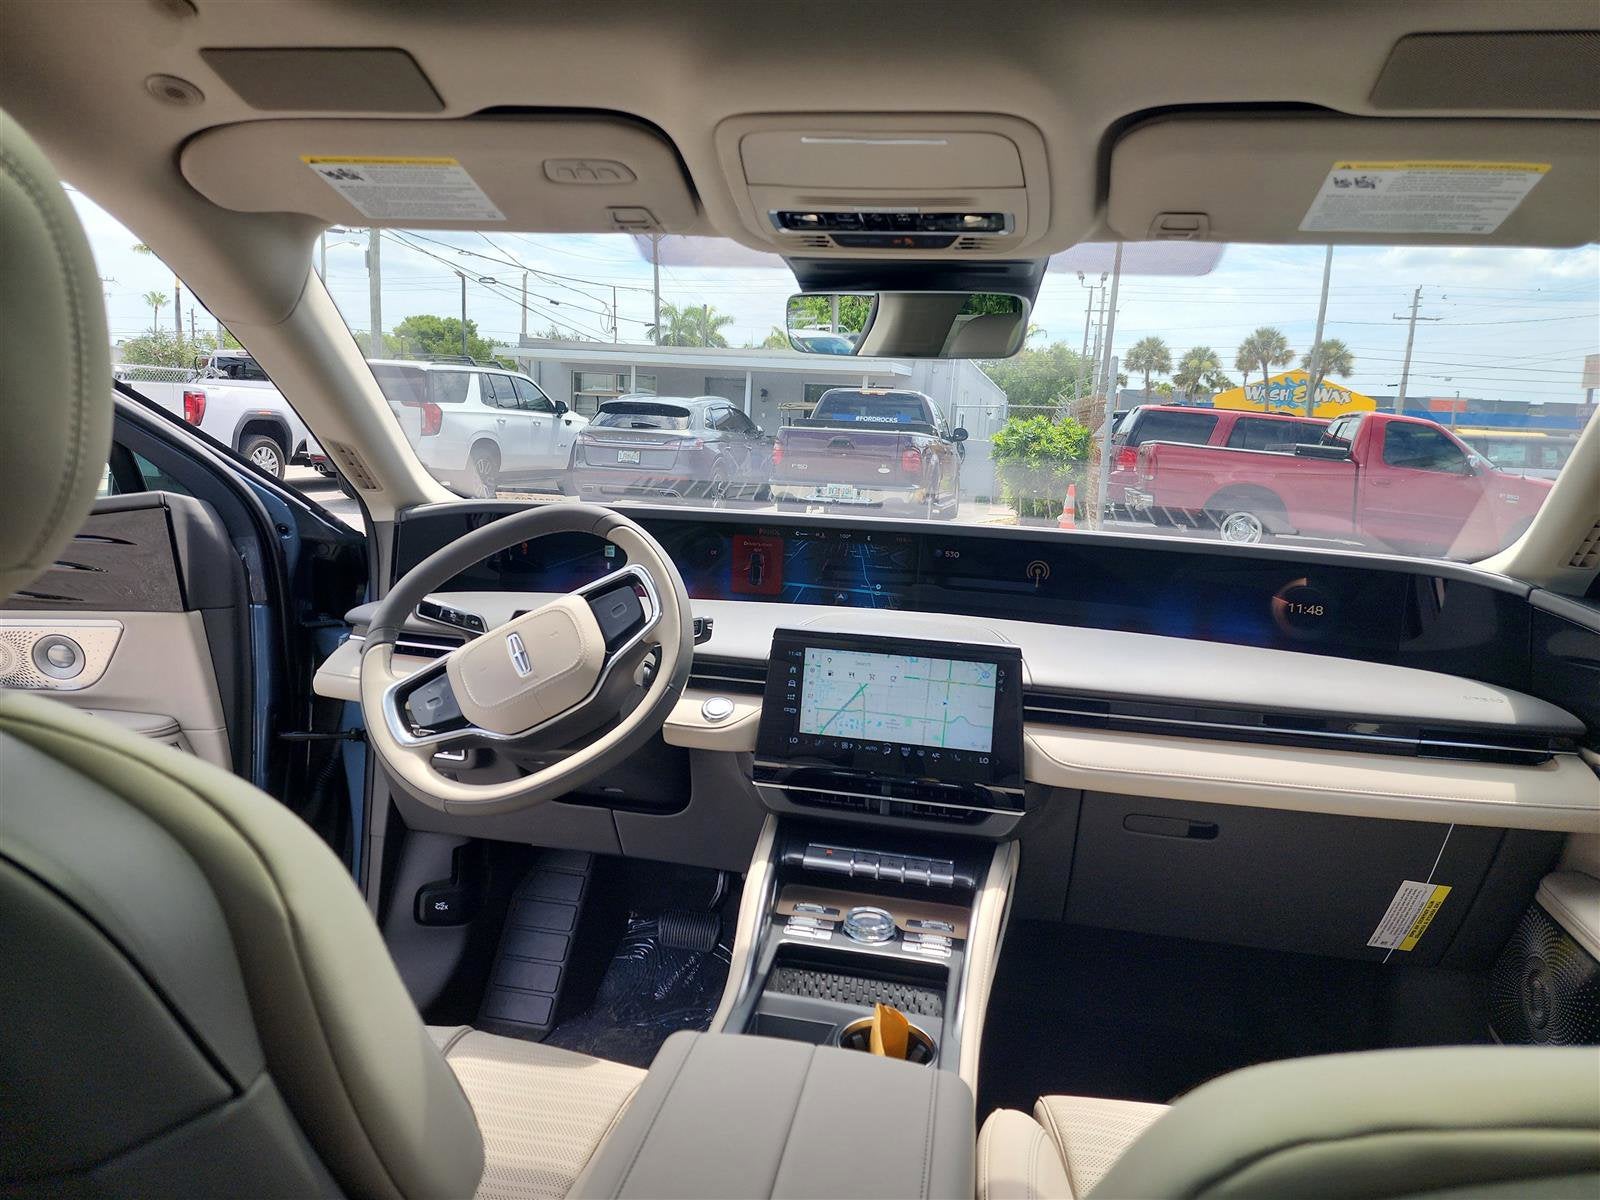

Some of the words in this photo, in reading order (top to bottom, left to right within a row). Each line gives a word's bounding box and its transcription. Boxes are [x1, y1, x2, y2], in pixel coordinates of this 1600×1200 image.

[1245, 385, 1290, 402] WASH
[1313, 386, 1353, 405] WAX
[855, 415, 898, 423] #FORDROCKS
[1288, 603, 1324, 616] 11:48
[789, 736, 799, 744] LO
[979, 756, 989, 765] LO
